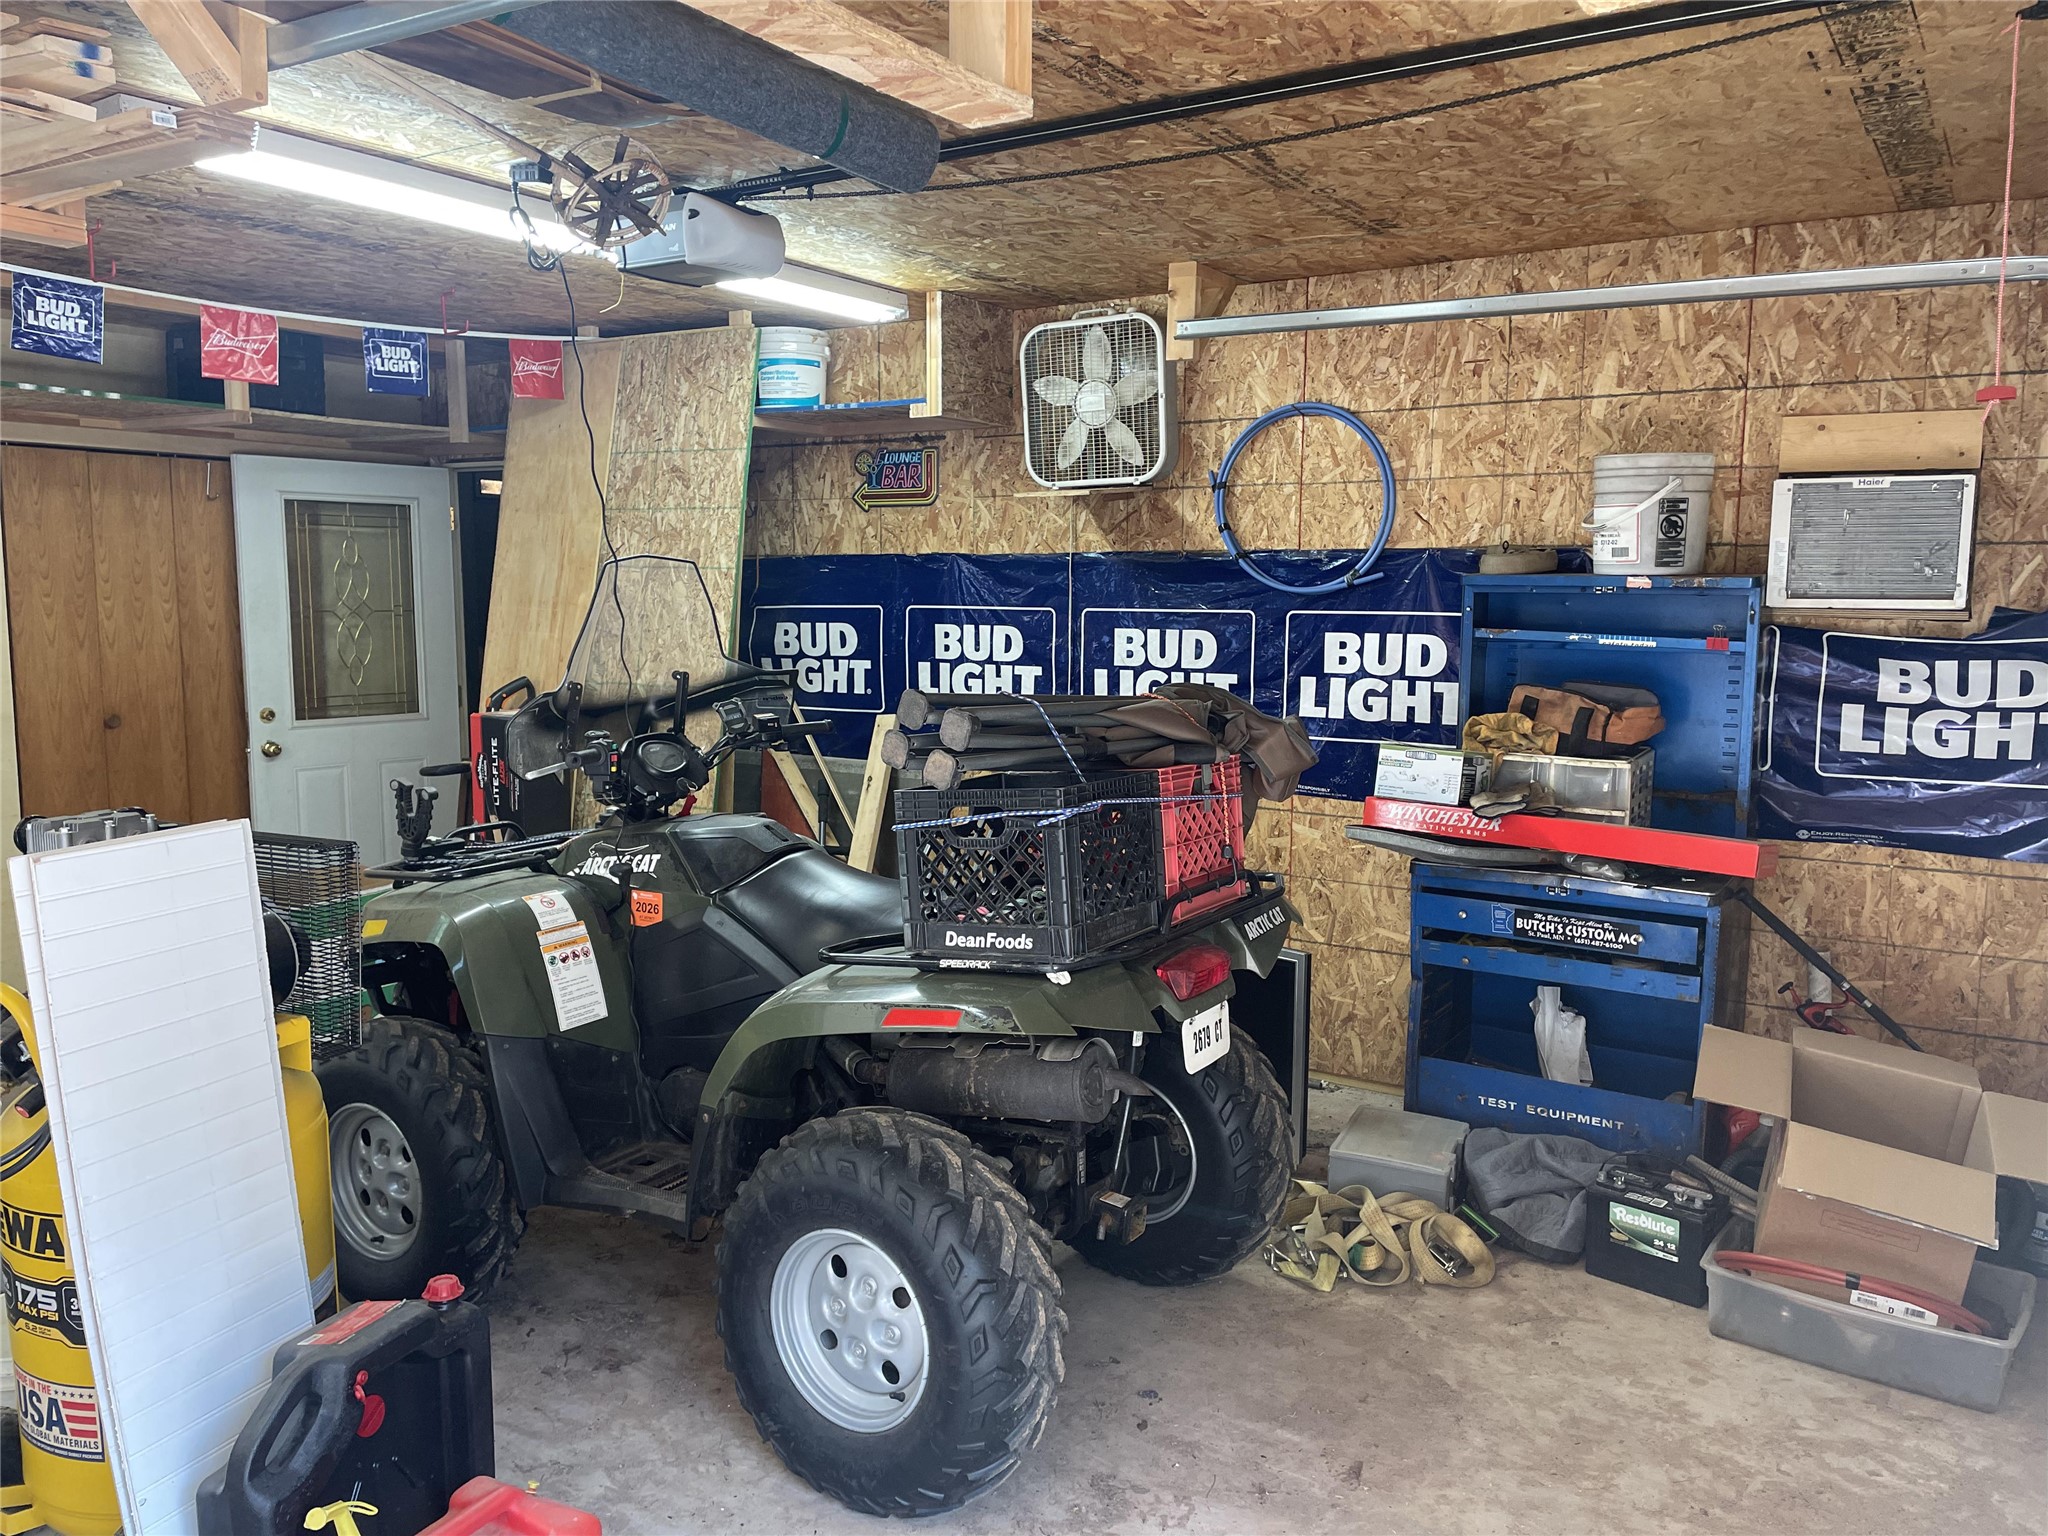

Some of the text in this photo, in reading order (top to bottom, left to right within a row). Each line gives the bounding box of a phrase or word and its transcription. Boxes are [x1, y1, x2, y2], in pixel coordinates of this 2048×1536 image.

[35, 295, 81, 317] BUD
[27, 309, 89, 335] LIGHT
[212, 332, 268, 352] Budweiser
[381, 345, 412, 360] BUD
[375, 357, 419, 375] LIGHT
[884, 452, 922, 464] LOUNGE
[881, 464, 922, 489] BAR
[1858, 478, 1885, 487] Haier
[774, 622, 858, 657] BUD
[934, 623, 1024, 662] BUD
[1113, 627, 1218, 669] BUD
[1323, 632, 1448, 678] BUD
[917, 661, 1043, 694] LIGHT
[1876, 658, 2048, 708] BUD
[1299, 676, 1460, 726] LIGHT
[1839, 703, 2048, 760] LIGH
[1386, 803, 1503, 832] WINCHESTER
[1459, 829, 1487, 837] ARMS
[631, 854, 661, 873] CAT
[636, 901, 660, 915] 2026
[1244, 906, 1286, 941] ARCTIC CAT
[1516, 917, 1564, 934] BUTCH'S
[1565, 924, 1616, 942] CUSTOM
[1591, 940, 1624, 950] 487-6100
[939, 959, 991, 970] SPEEDRACK
[1215, 1018, 1223, 1043] CT
[1478, 1096, 1624, 1130] TEST EQUIPMENT
[1613, 1206, 1676, 1236] Resolute
[1653, 1239, 1676, 1251] 24 12
[16, 1281, 57, 1312] 175
[18, 1301, 59, 1321] MAX PSI
[28, 1378, 35, 1390] IN
[37, 1381, 51, 1396] THE
[17, 1379, 68, 1436] USA
[30, 1424, 52, 1442] GLOBAL
[53, 1434, 99, 1450] MATERIALS
